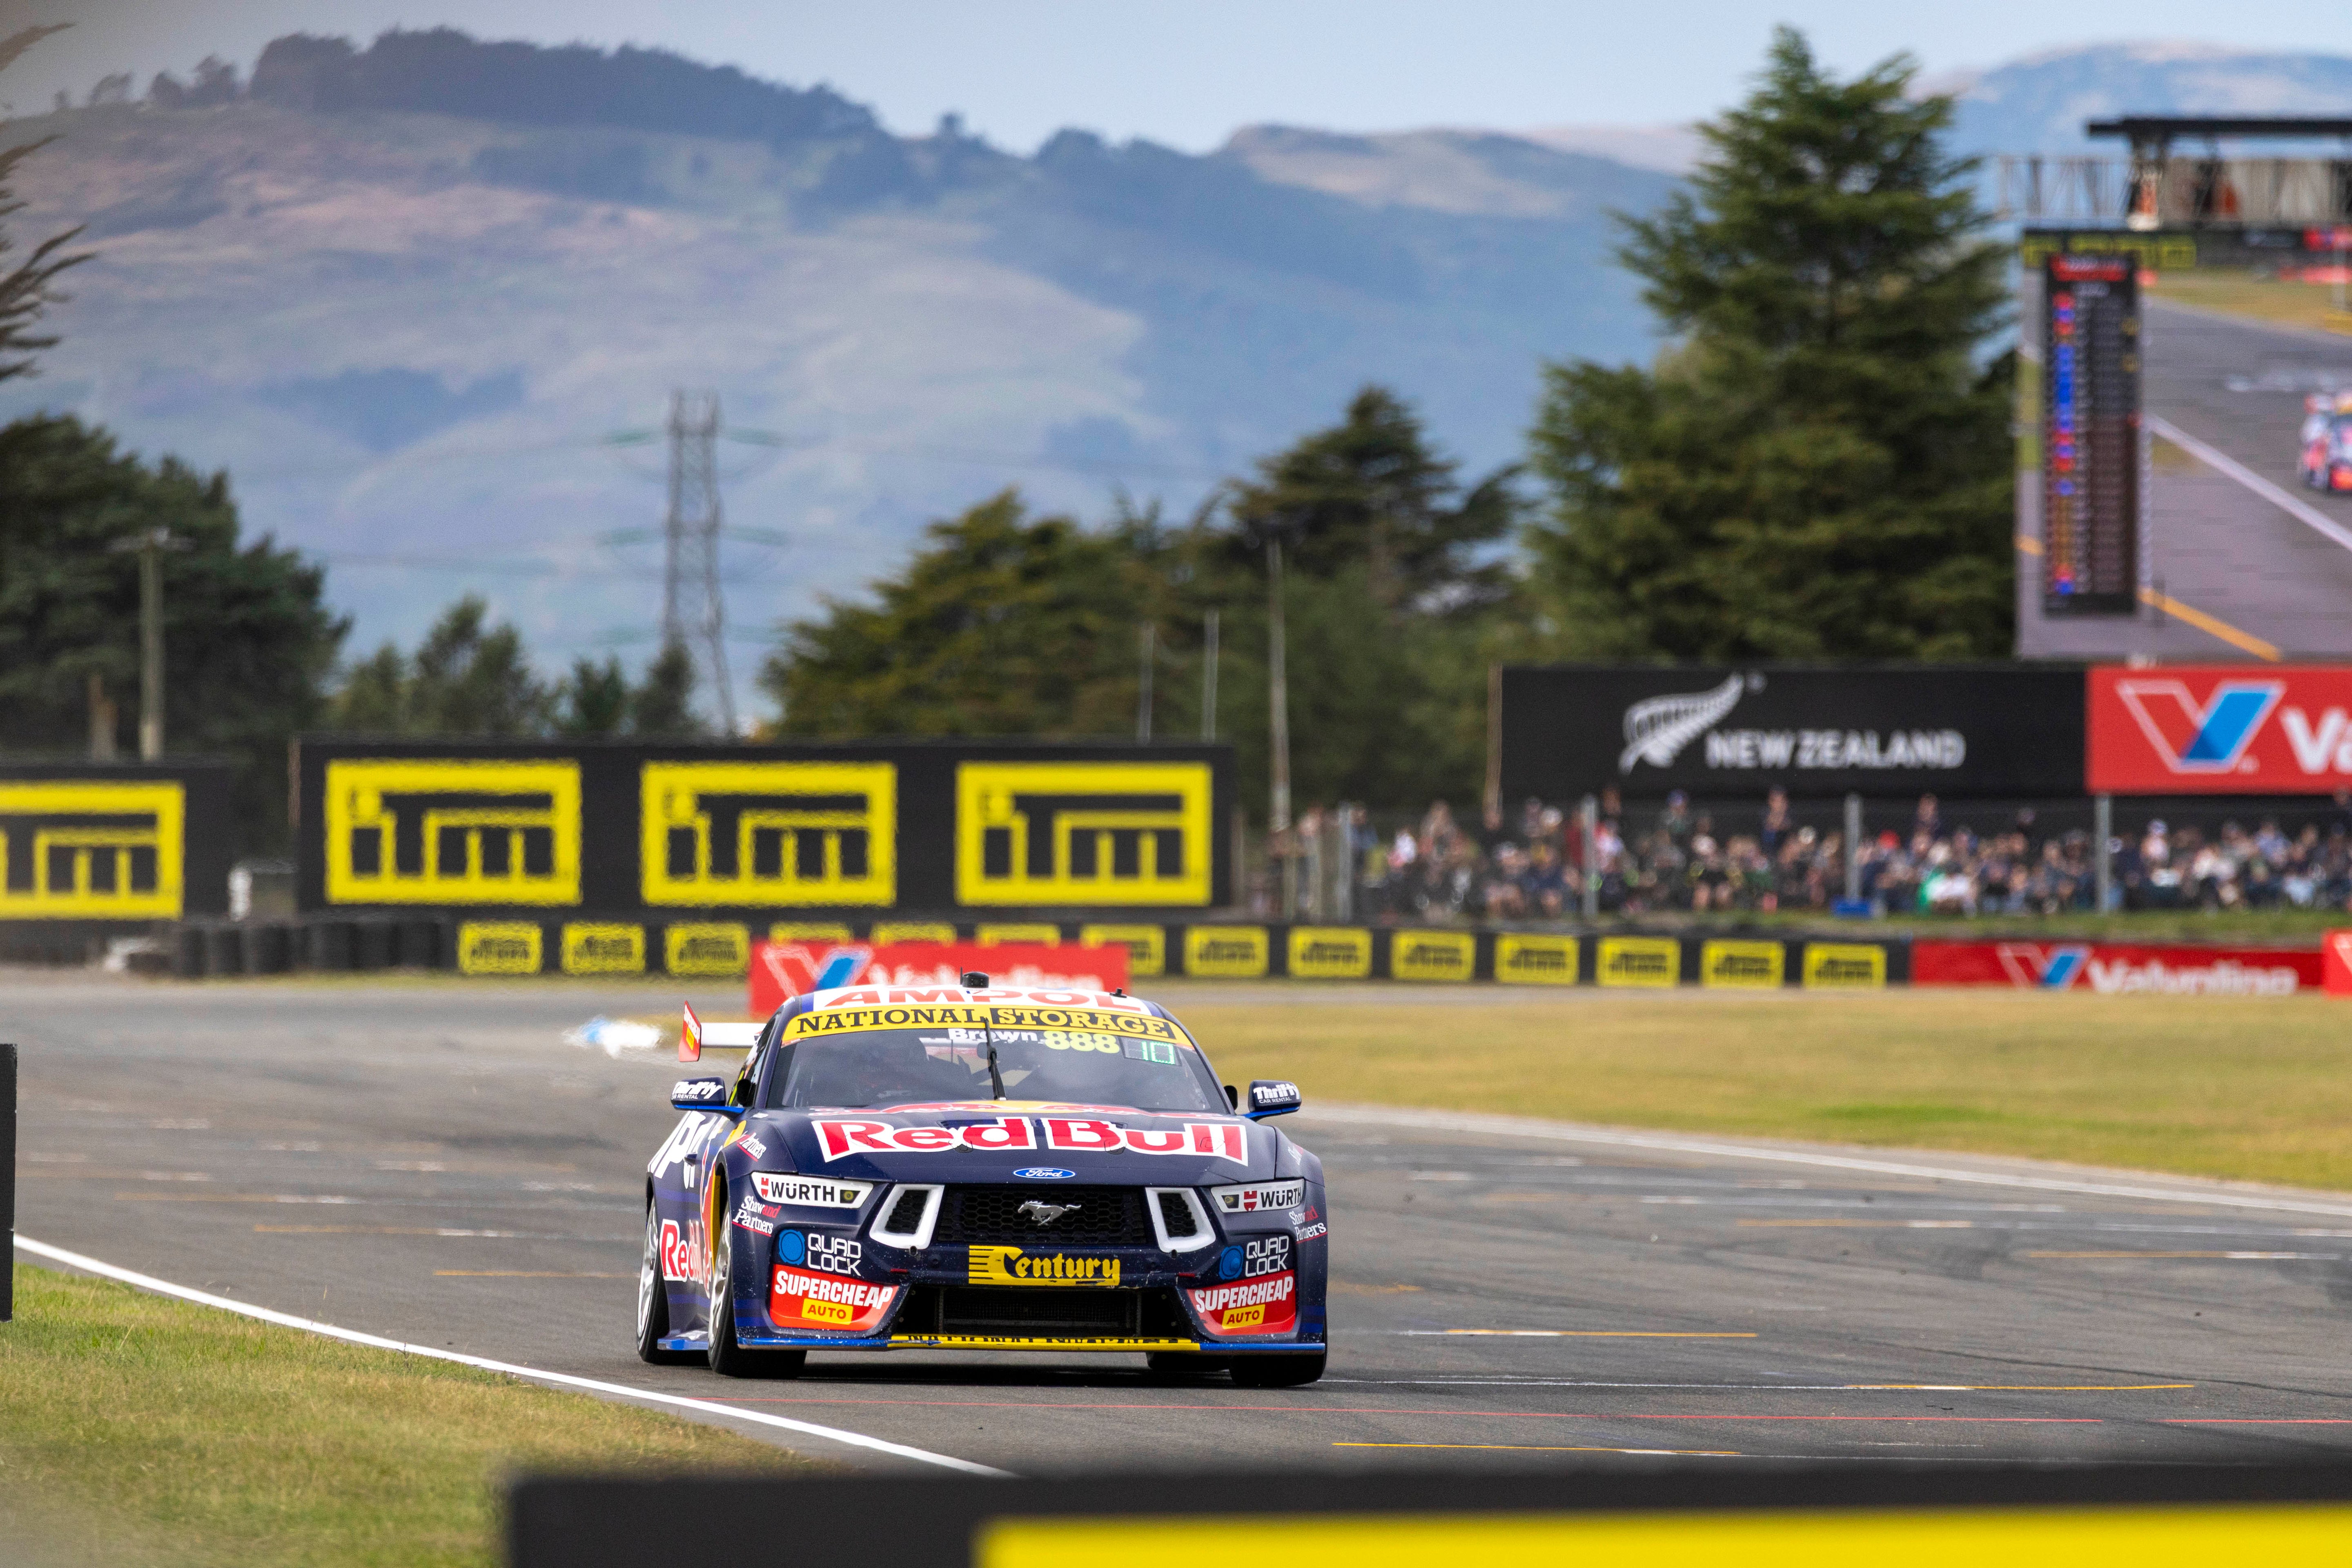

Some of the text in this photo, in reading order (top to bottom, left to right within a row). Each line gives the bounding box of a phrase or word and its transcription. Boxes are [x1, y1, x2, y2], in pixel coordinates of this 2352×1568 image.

[1705, 729, 1966, 769] NEW ZEALAND
[824, 989, 1141, 1011] AMPOL
[796, 1008, 1169, 1038] NATIONAL STORAGE
[948, 1028, 1038, 1042] Brown
[1043, 1030, 1120, 1054] 888
[1142, 1040, 1175, 1065] 10
[1253, 1083, 1300, 1100] Thrifty
[812, 1116, 1037, 1163] Red
[1040, 1118, 1249, 1167] Bull
[1025, 1169, 1063, 1177] Ford
[741, 1195, 782, 1218] Shaw and
[1289, 1210, 1305, 1225] Shaw
[733, 1209, 773, 1234] Partners
[1294, 1223, 1327, 1241] Partners
[807, 1233, 861, 1259] QUAD
[1246, 1235, 1289, 1260] QUAD
[807, 1250, 861, 1276] LOCK
[982, 1245, 1120, 1285] Century
[1245, 1252, 1289, 1278] LOCK
[775, 1270, 893, 1310] SUPERCHEAP
[1195, 1276, 1294, 1314] SUPERCHEAP
[807, 1304, 846, 1319] AUTO
[1227, 1310, 1260, 1325] AUTO
